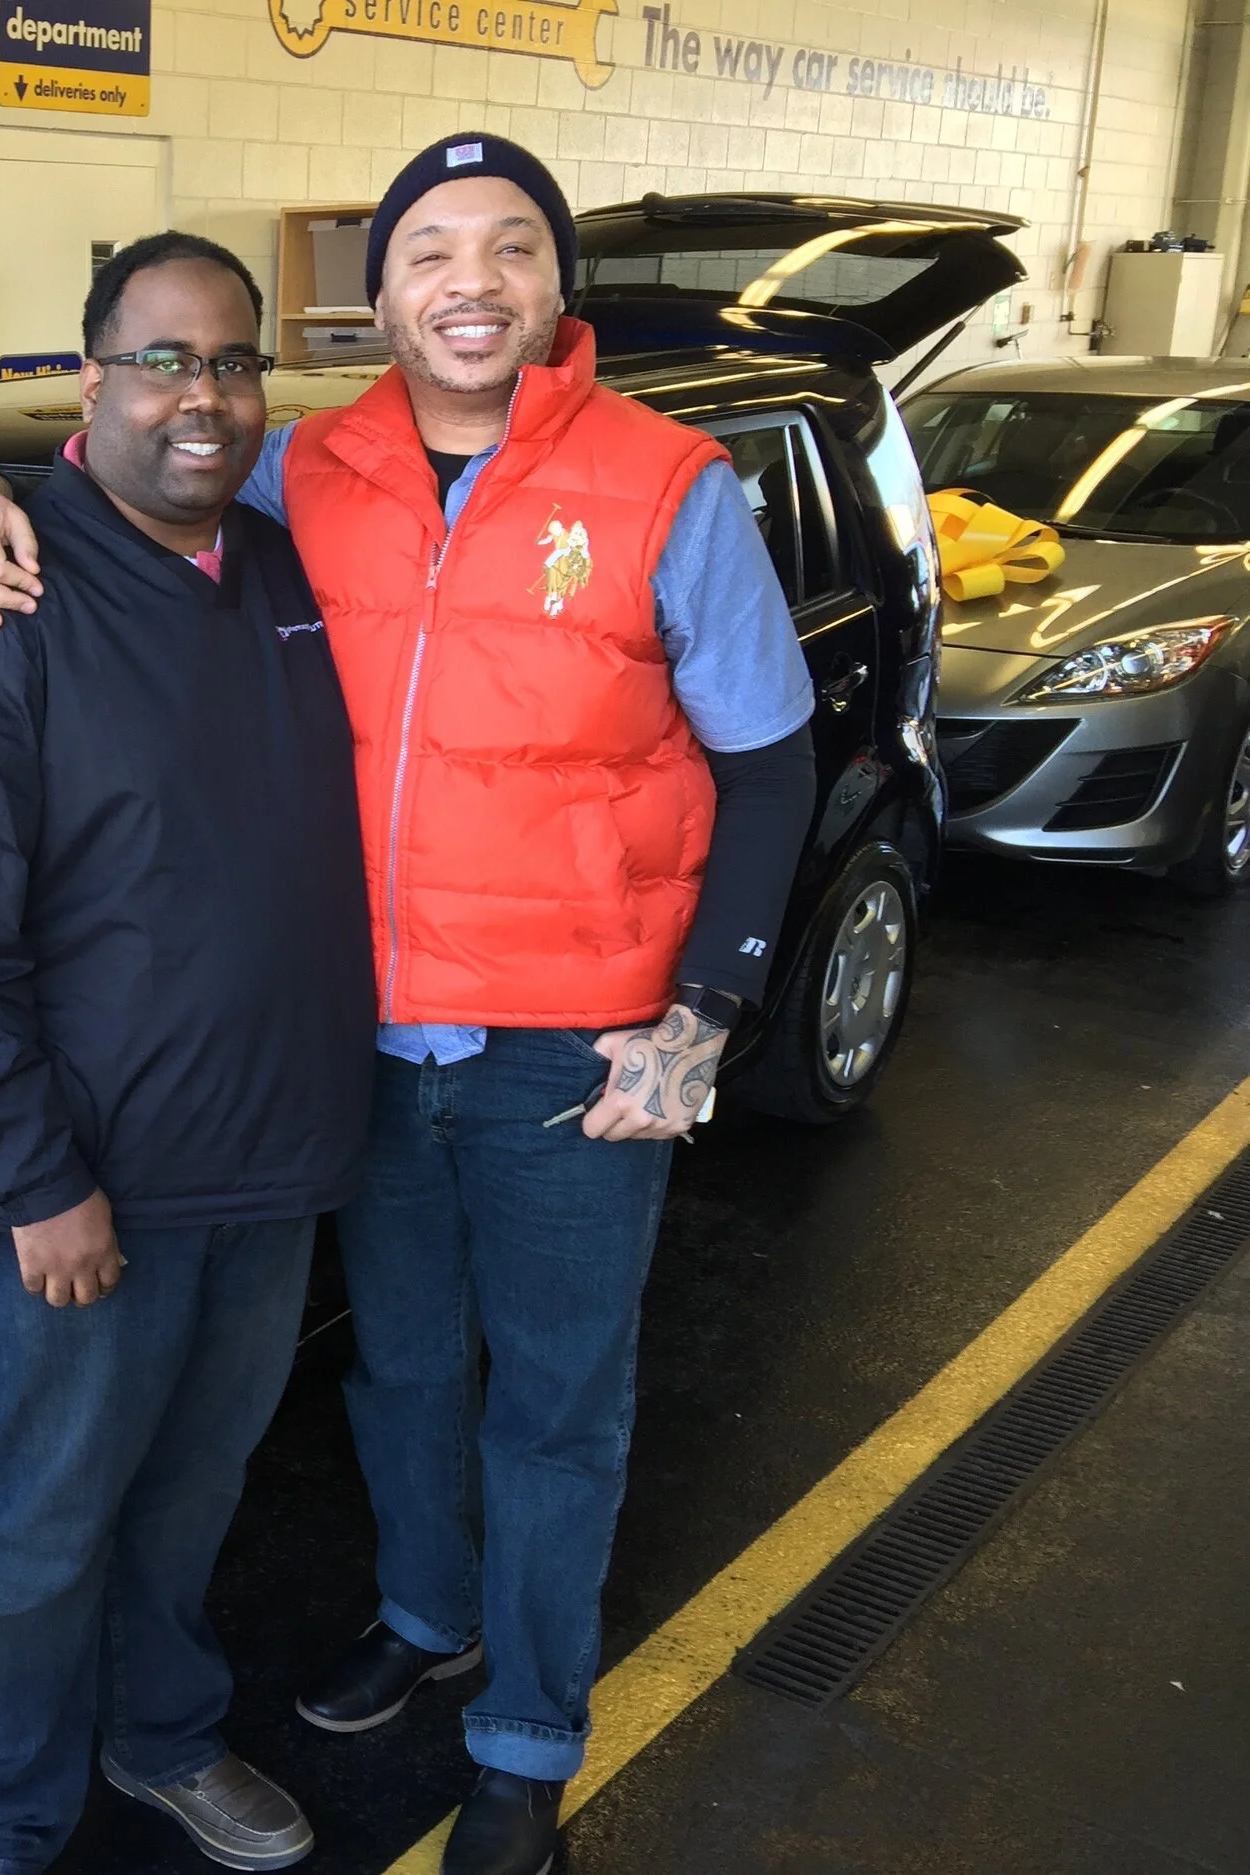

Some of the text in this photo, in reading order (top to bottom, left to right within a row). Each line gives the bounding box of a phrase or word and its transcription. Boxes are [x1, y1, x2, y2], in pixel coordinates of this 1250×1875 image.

[6, 6, 143, 52] department
[344, 0, 565, 45] service center
[641, 3, 702, 73] The
[713, 35, 785, 100] way
[791, 47, 840, 91] car
[845, 48, 935, 106] service
[942, 56, 1018, 115] should
[34, 78, 127, 108] deliveries only
